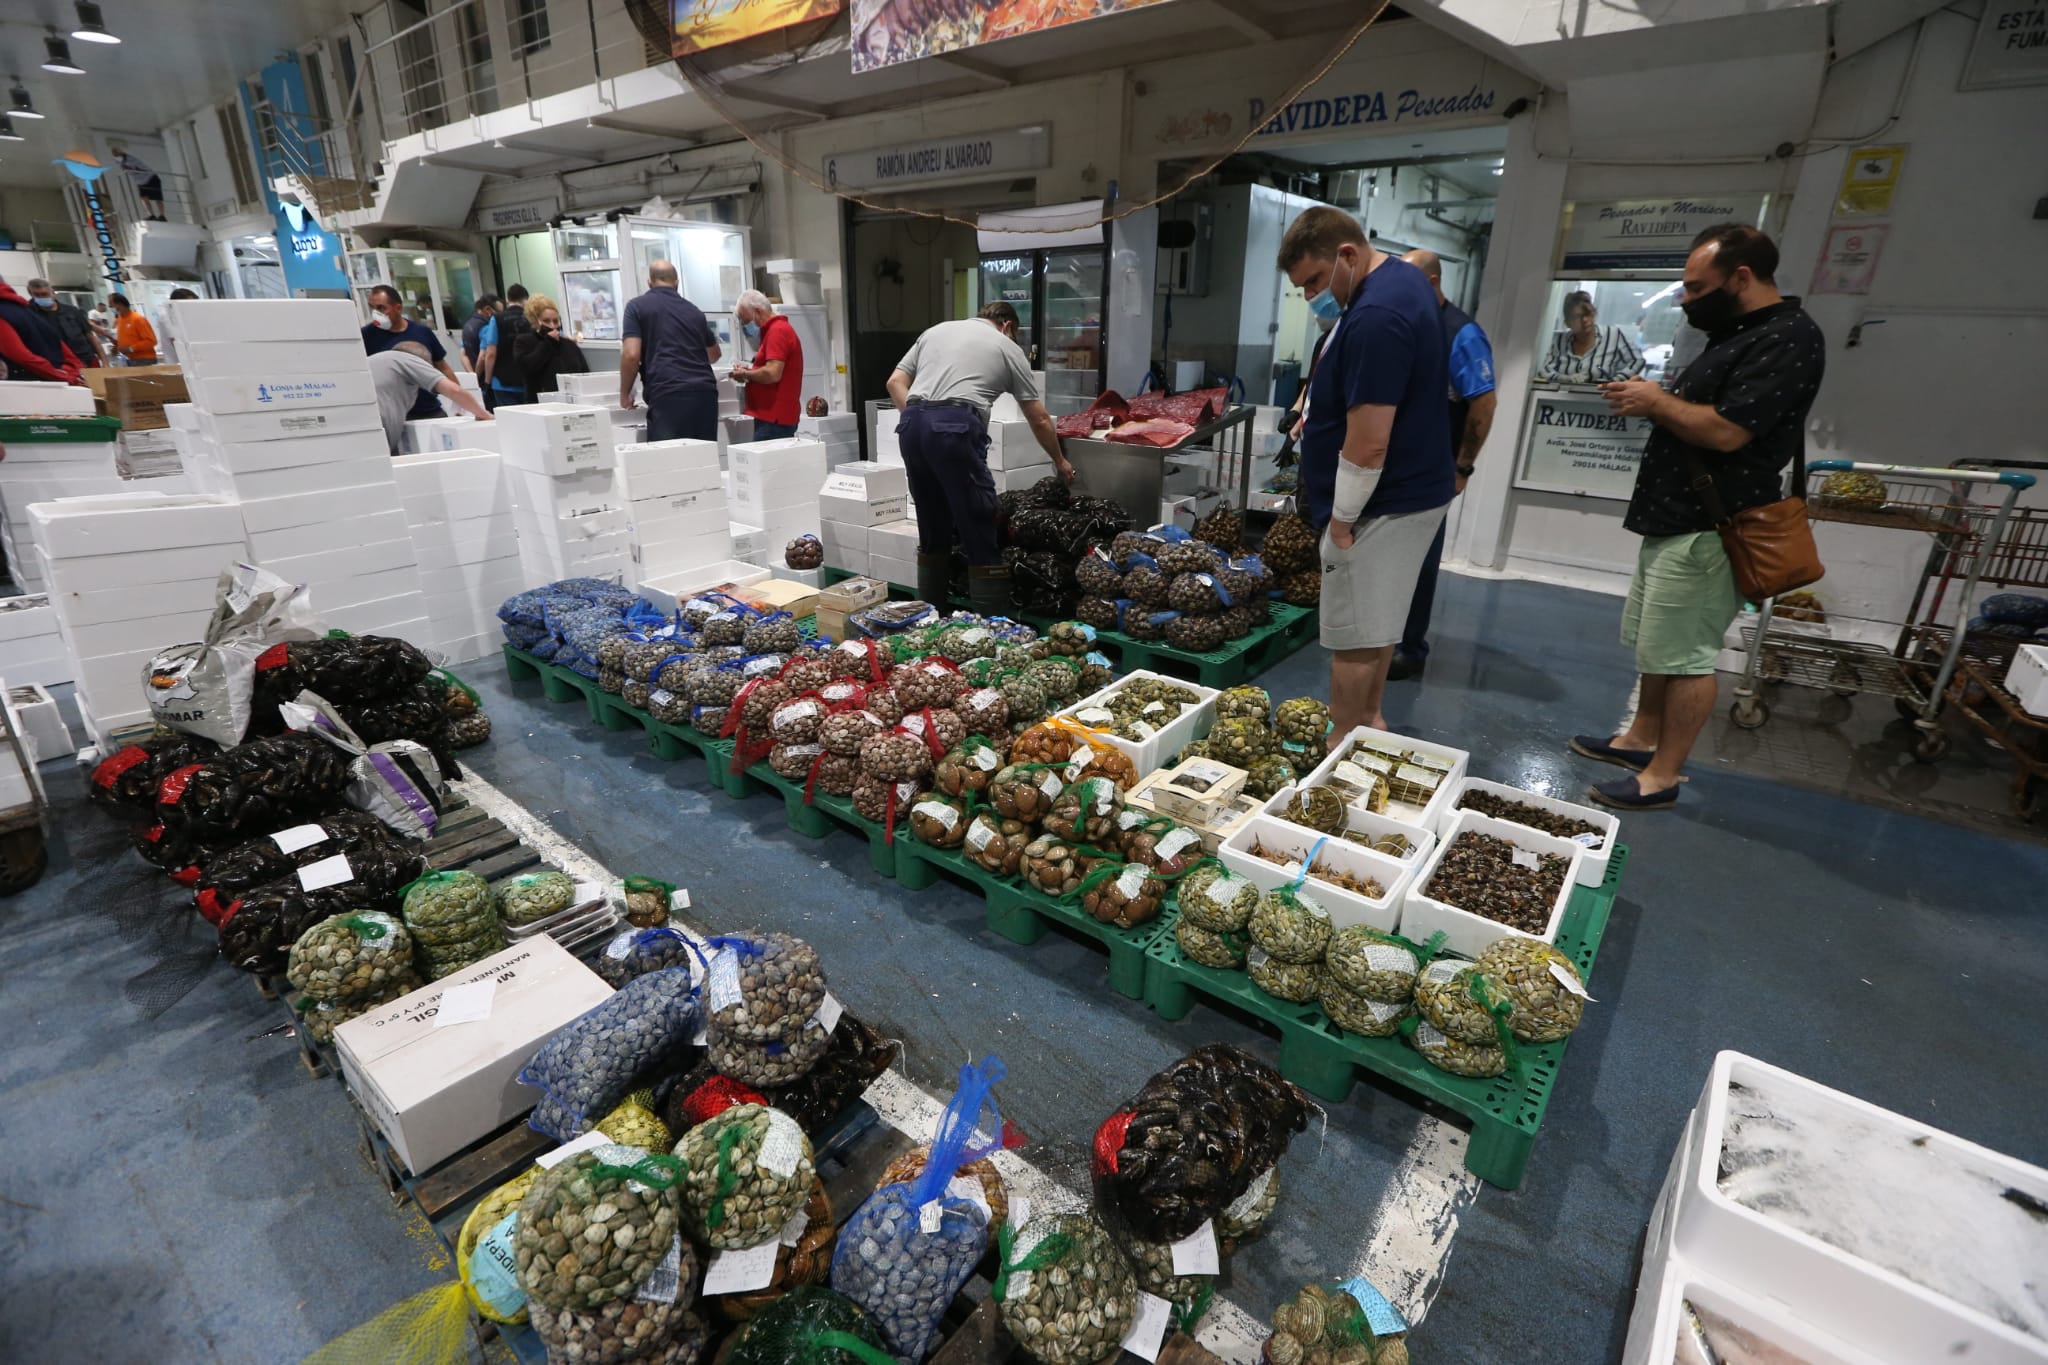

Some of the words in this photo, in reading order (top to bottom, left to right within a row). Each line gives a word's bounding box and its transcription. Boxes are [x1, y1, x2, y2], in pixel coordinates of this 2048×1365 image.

[1249, 91, 1387, 136] RAVIDEPA
[1395, 85, 1495, 122] Pescados
[828, 159, 837, 186] 6
[876, 149, 905, 179] RAMÓN
[907, 148, 941, 175] ANDREU
[943, 141, 992, 170] ALVARADO
[1598, 204, 1656, 222] Pescados
[1659, 206, 1670, 216] y
[1672, 201, 1734, 215] Mariscos
[82, 188, 126, 284] Aquamar
[1620, 218, 1687, 235] RAVIDEPA
[1538, 405, 1628, 432] RAVIDEPA
[1561, 449, 1613, 461] Mercamálaga
[1588, 442, 1616, 452] Ortega
[468, 952, 531, 984] MANTENER
[403, 1007, 411, 1015] Y
[406, 1007, 440, 1023] GIL
